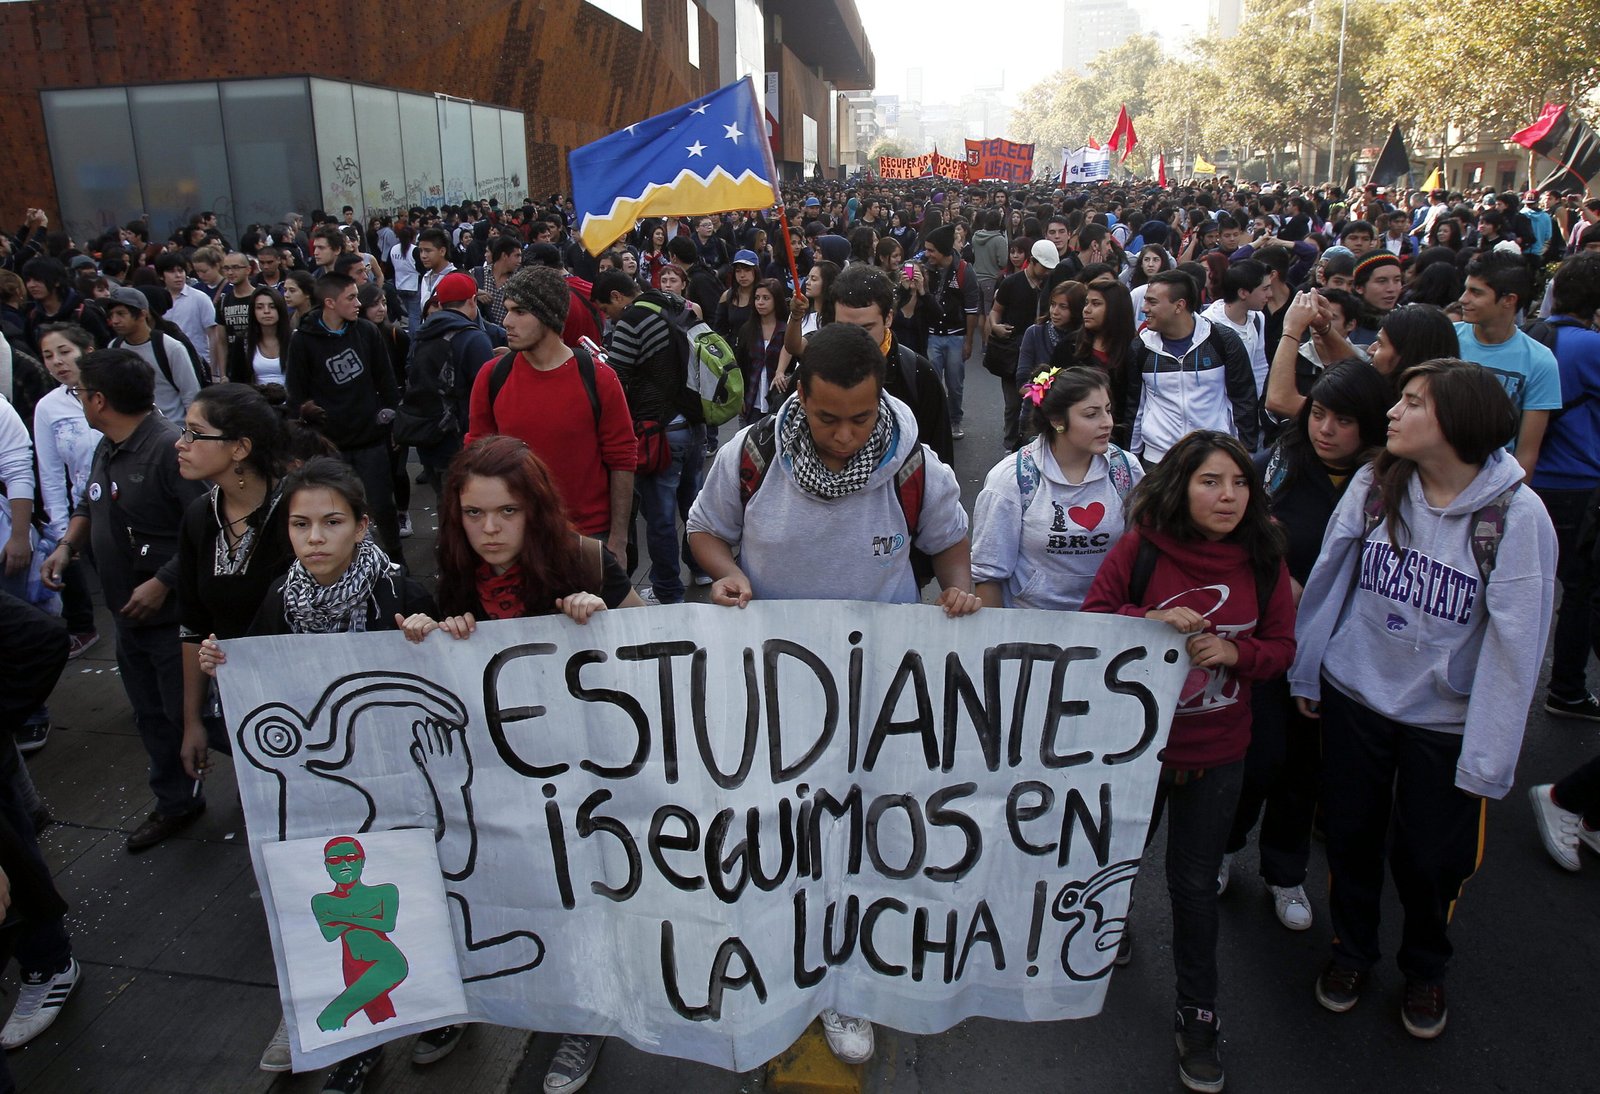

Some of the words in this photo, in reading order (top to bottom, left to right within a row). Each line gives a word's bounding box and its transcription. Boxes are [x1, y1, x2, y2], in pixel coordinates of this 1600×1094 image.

[880, 155, 928, 169] RECUPERAR
[880, 168, 902, 178] PARA
[905, 169, 914, 178] EL
[1046, 533, 1110, 549] BRC
[1412, 554, 1478, 625] STATE
[660, 920, 768, 1021] LA
